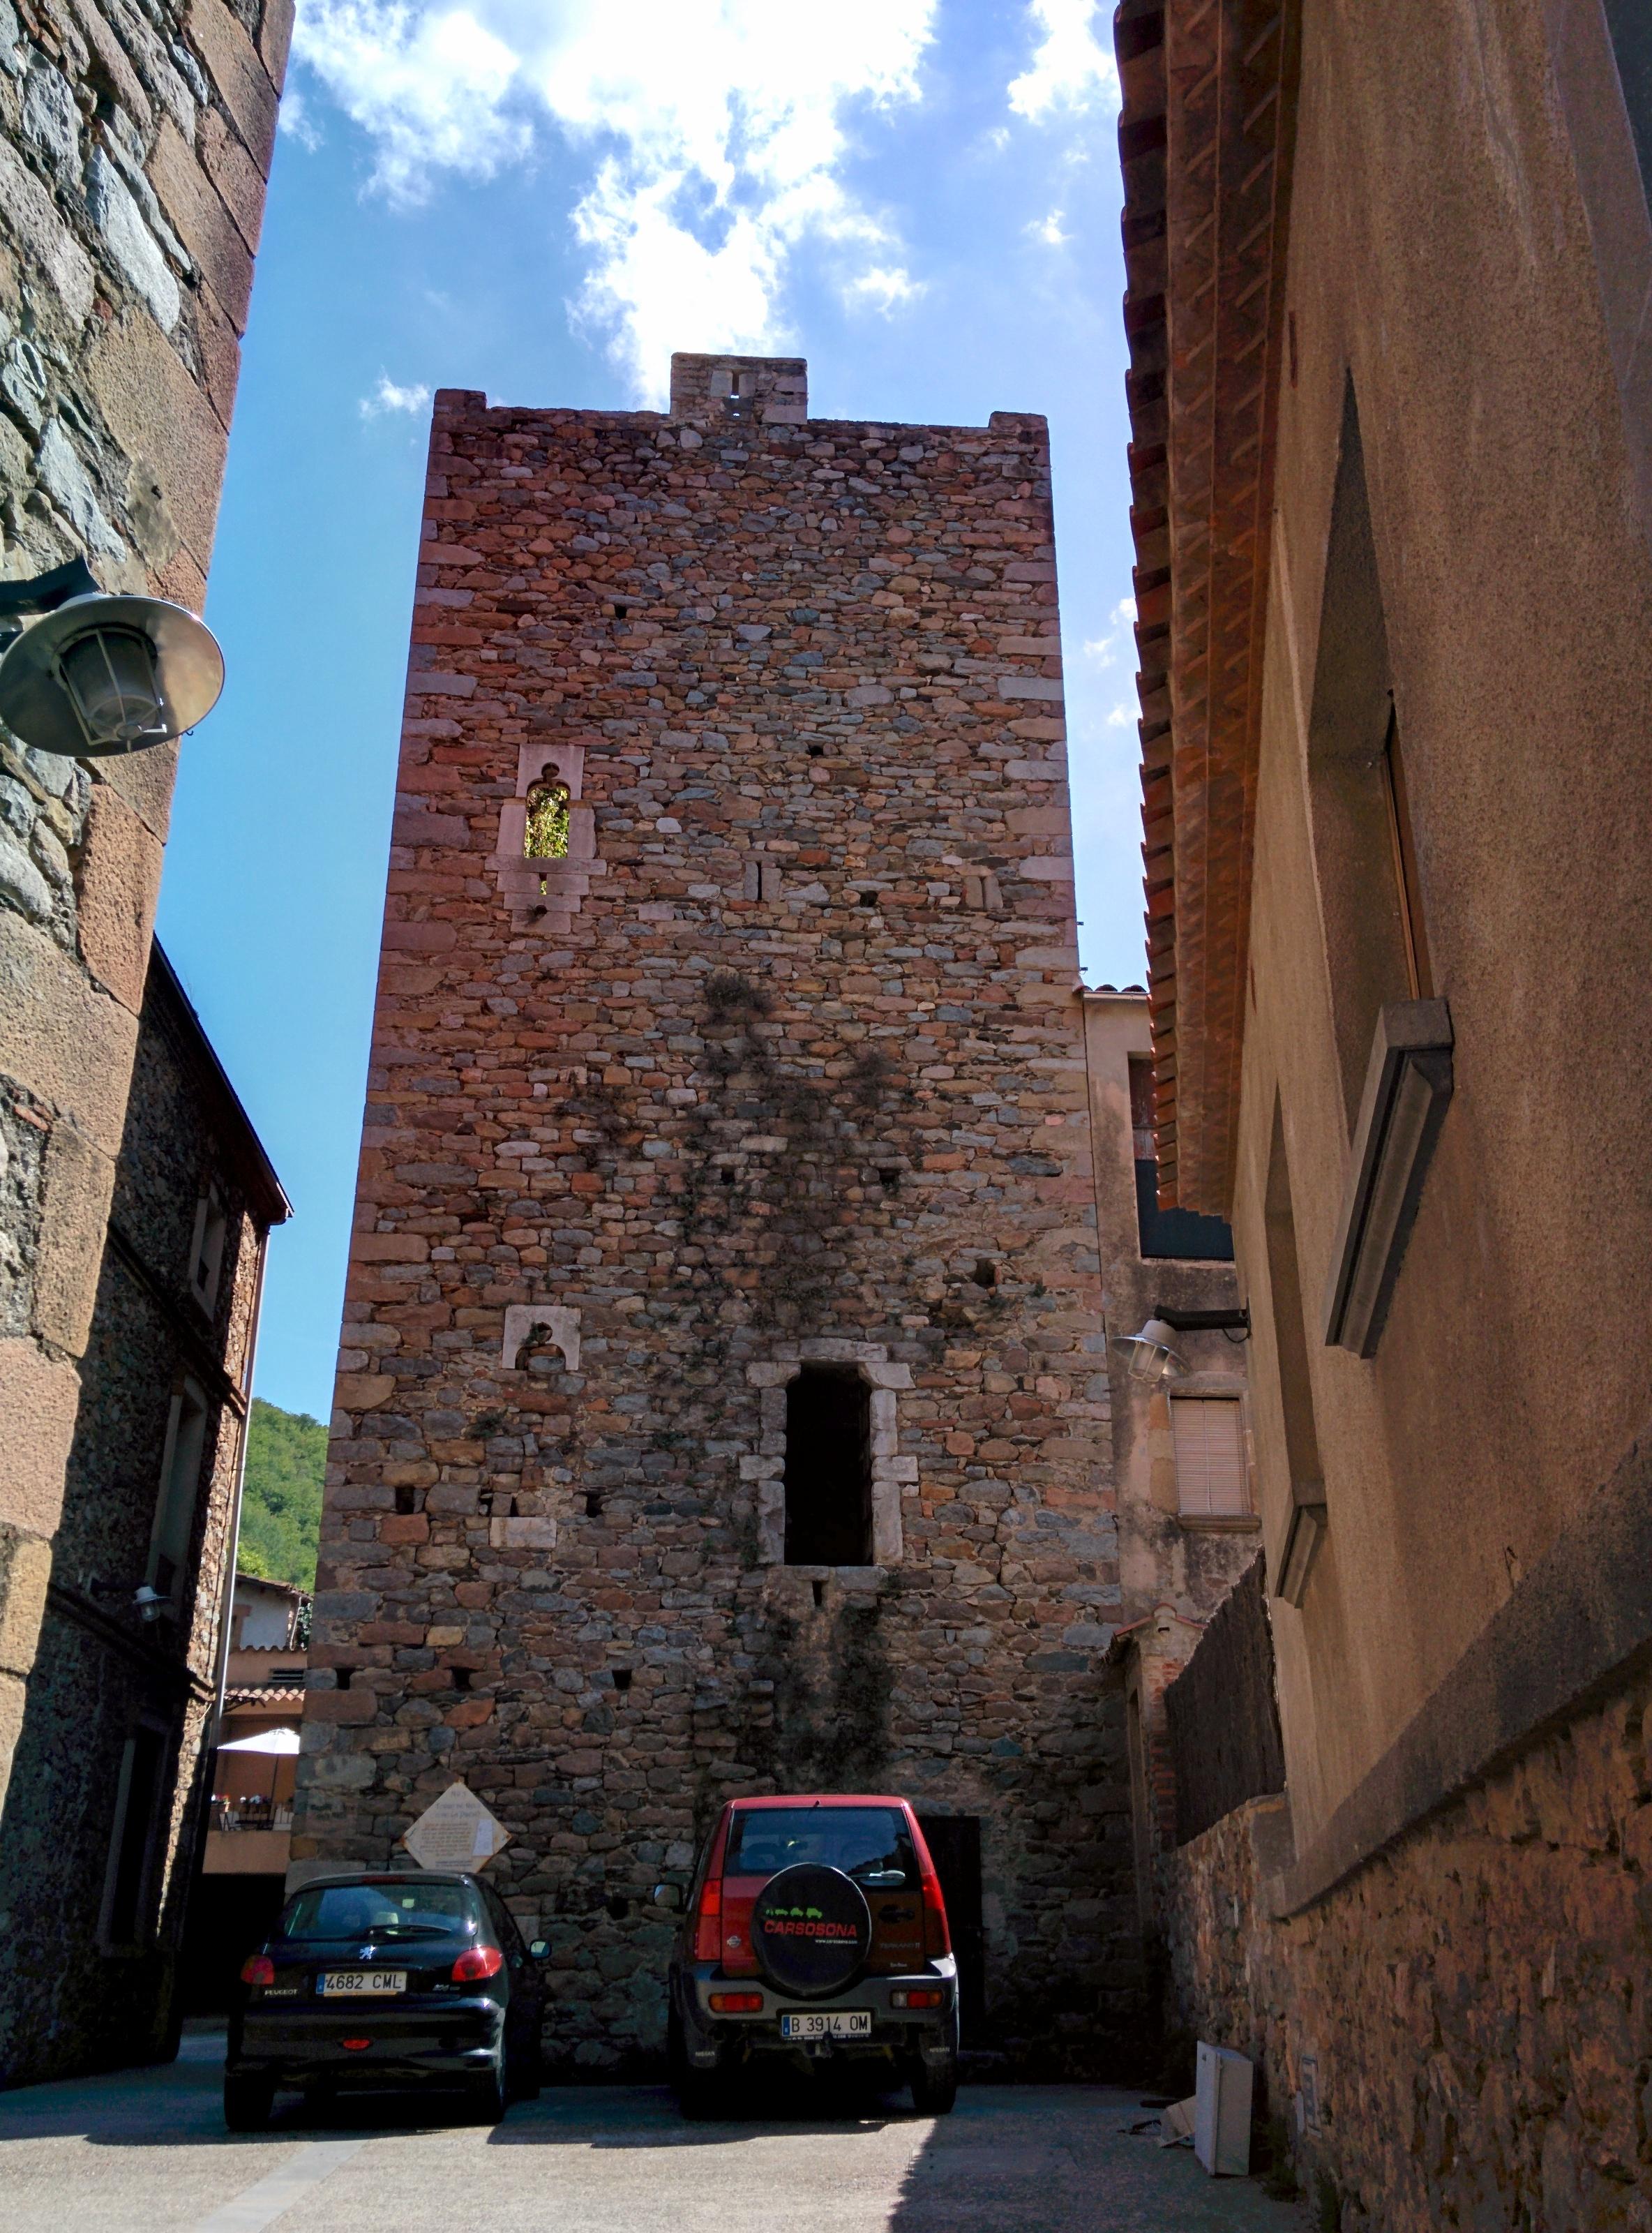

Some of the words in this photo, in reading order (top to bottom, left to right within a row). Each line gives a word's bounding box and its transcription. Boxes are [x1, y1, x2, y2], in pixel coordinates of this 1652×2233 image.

[765, 1920, 857, 1937] CARSOSONA
[326, 1974, 364, 1990] 4682
[373, 1974, 401, 1989] CML
[264, 1988, 299, 1996] PEUGEOT
[791, 2017, 800, 2033] B
[806, 2015, 841, 2032] 3914
[850, 2015, 868, 2031] OM
